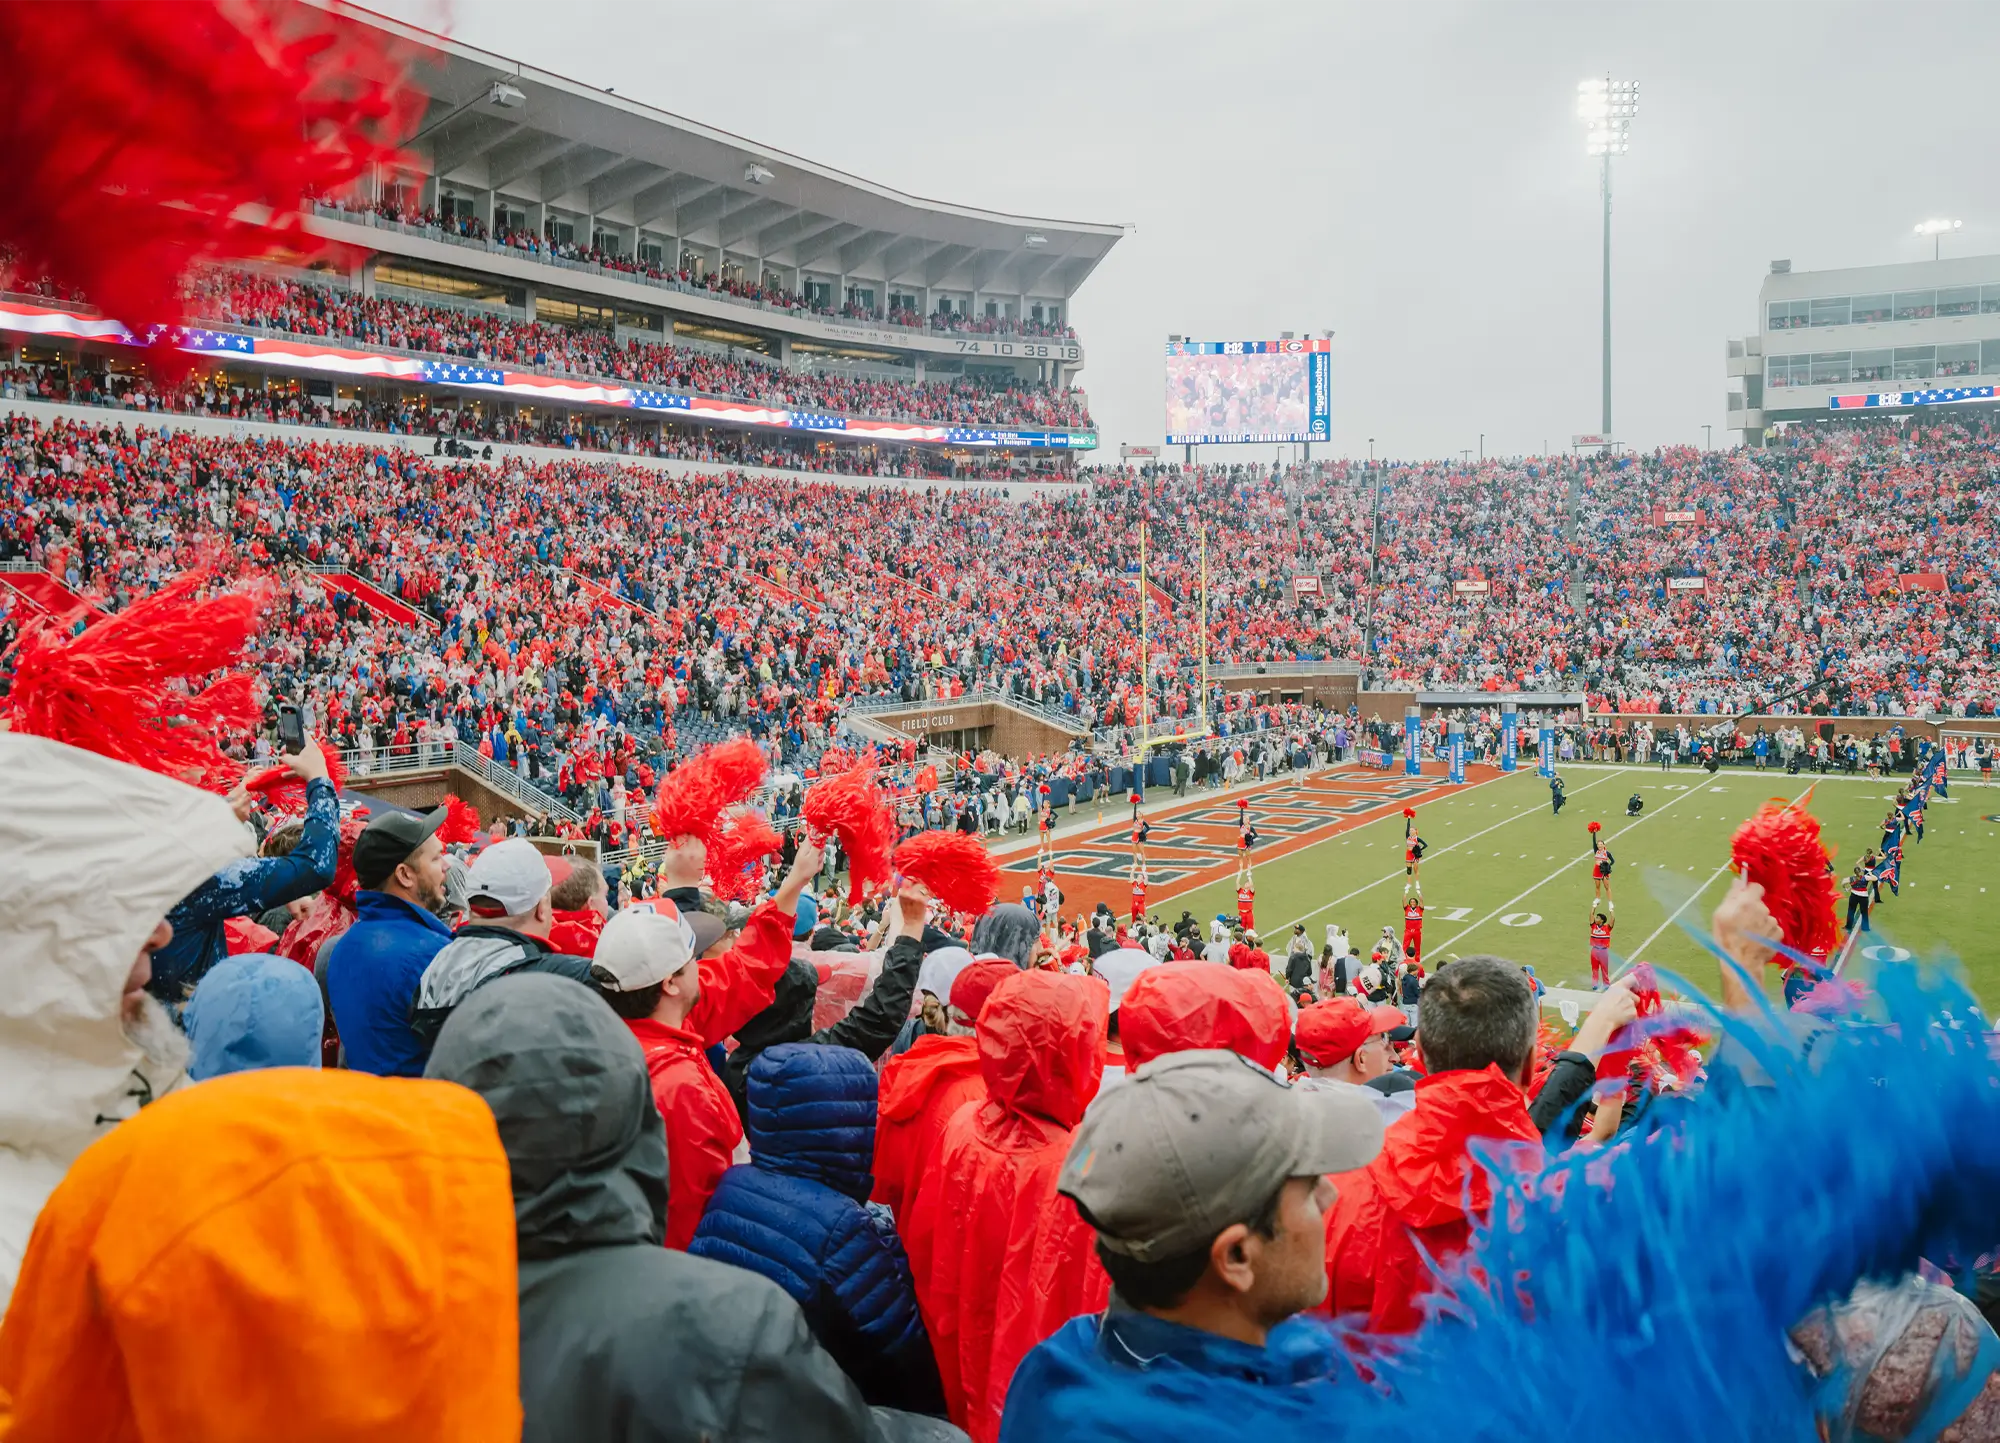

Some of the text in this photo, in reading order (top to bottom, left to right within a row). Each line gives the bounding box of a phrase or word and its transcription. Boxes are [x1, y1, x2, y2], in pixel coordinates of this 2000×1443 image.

[956, 341, 1080, 359] 74 10 38 18
[1224, 342, 1243, 354] 8:02
[1315, 355, 1324, 416] Higginbotham
[1879, 393, 1902, 406] 8:02
[1069, 436, 1096, 445] BankPlus
[1171, 432, 1326, 444] WELCOME TO VAUGHT-HEMINGWAY STADIUM
[901, 715, 954, 731] FIELD CLUB
[999, 771, 1456, 886] REBELS
[1363, 975, 1374, 991] REBS
